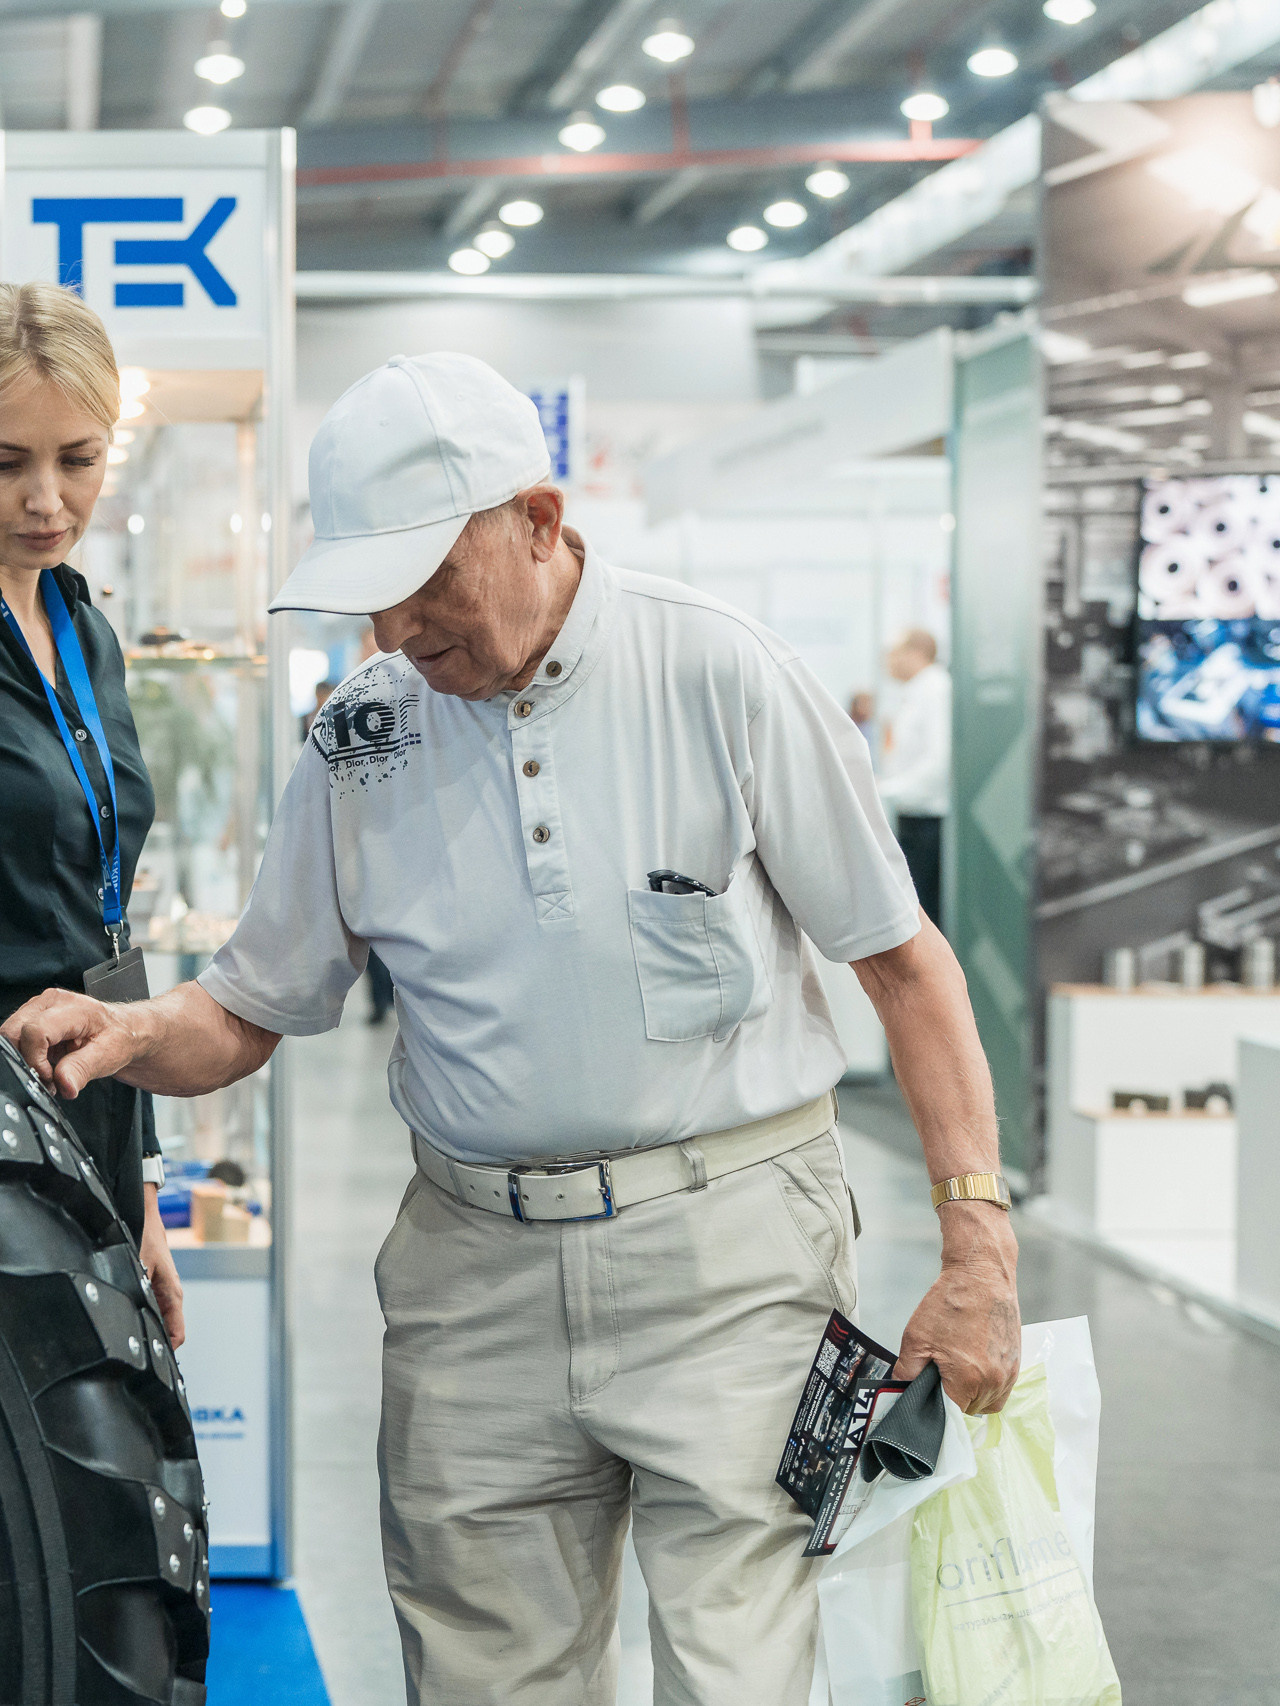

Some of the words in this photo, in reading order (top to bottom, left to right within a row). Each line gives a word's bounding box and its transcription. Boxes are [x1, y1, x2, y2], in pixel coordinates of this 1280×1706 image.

[817, 1525, 830, 1549] СХЕМА
[827, 1490, 842, 1525] ПРОХОДА
[841, 1455, 854, 1483] СТЕНДУ
